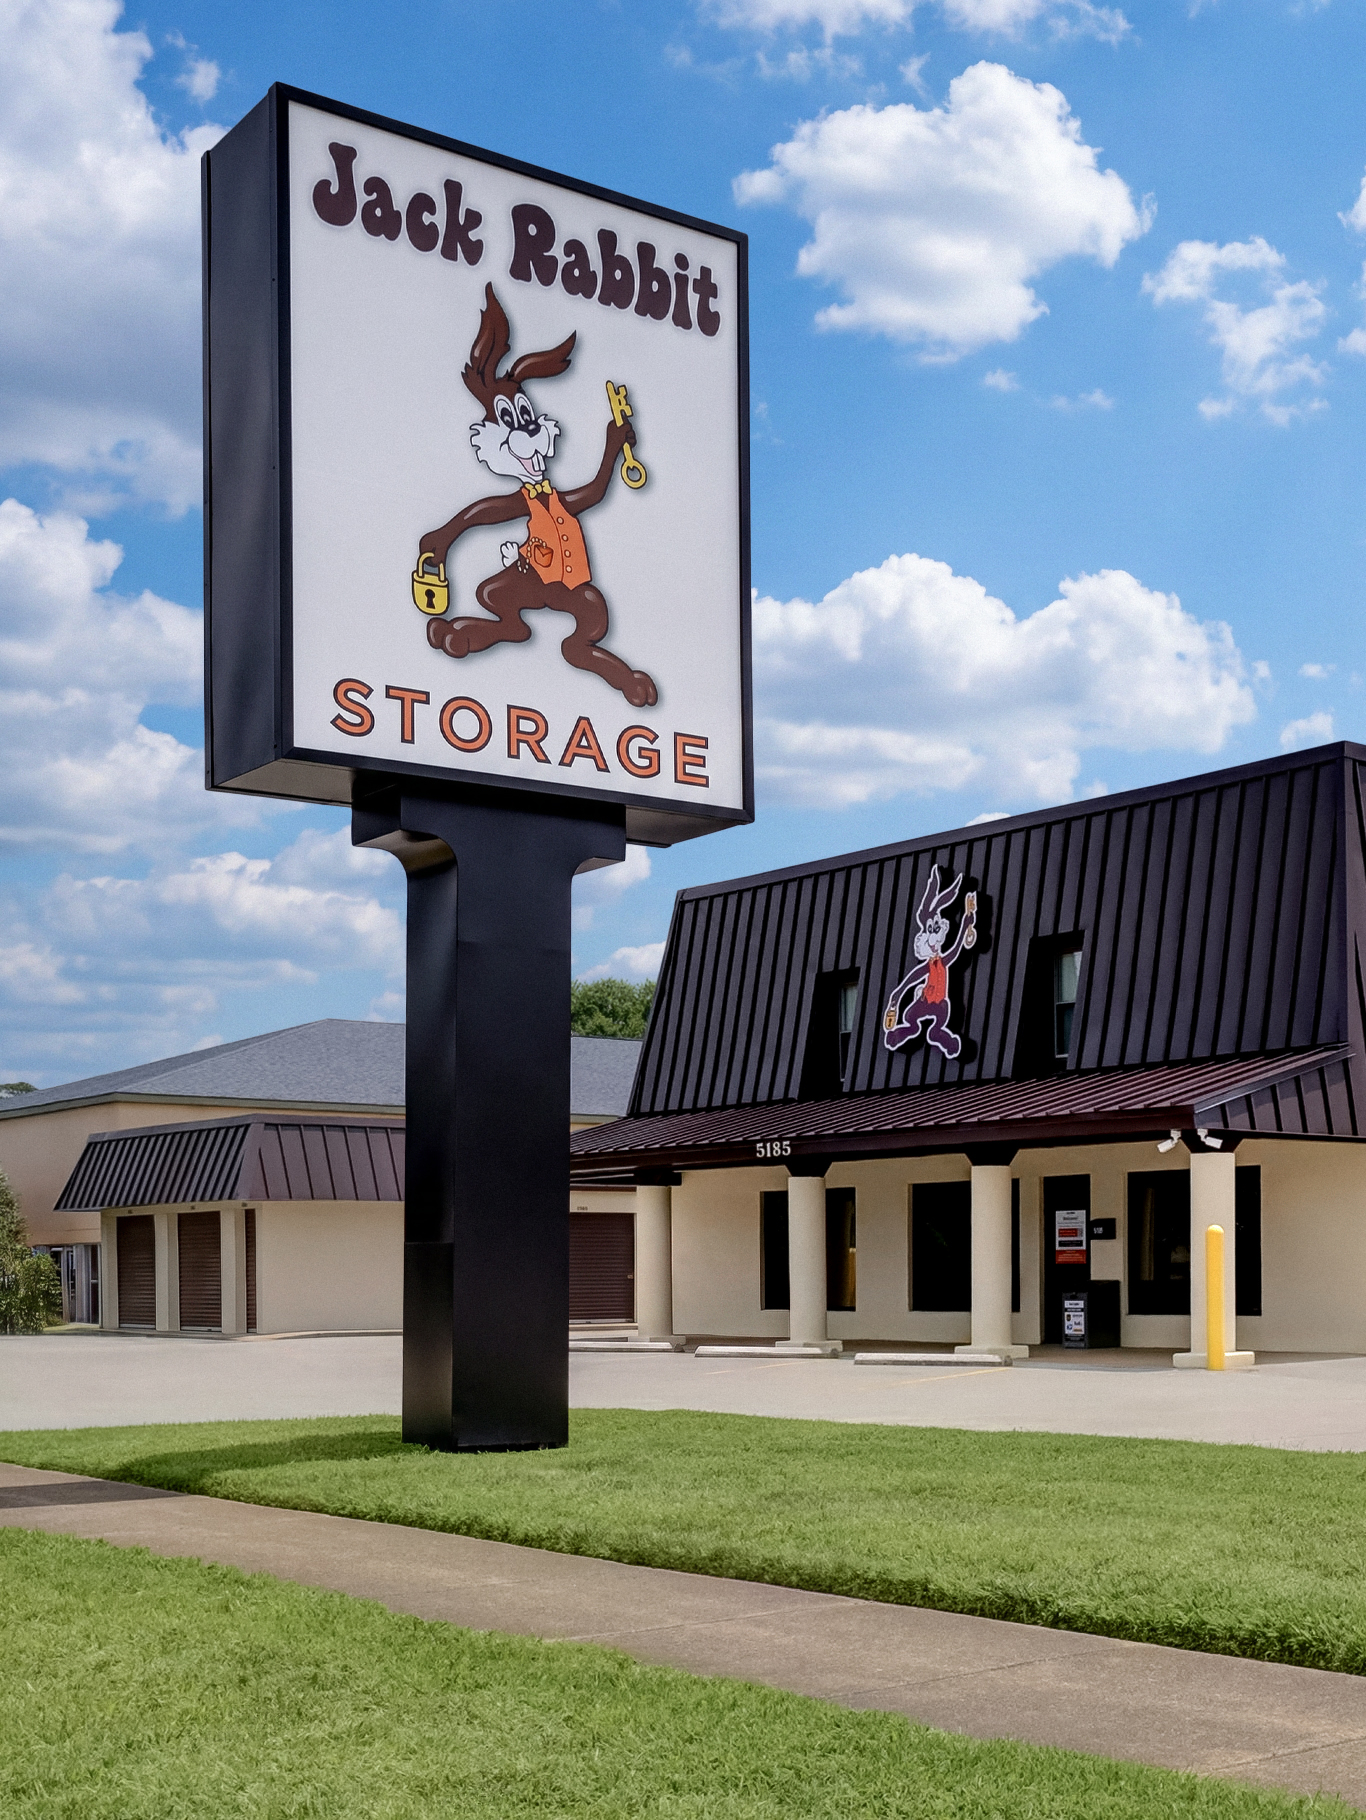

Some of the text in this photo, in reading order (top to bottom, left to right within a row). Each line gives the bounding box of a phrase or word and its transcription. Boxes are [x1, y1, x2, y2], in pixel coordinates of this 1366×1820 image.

[312, 141, 720, 337] Jack Rabbit
[330, 678, 710, 788] STORAGE
[755, 1140, 791, 1158] 5185
